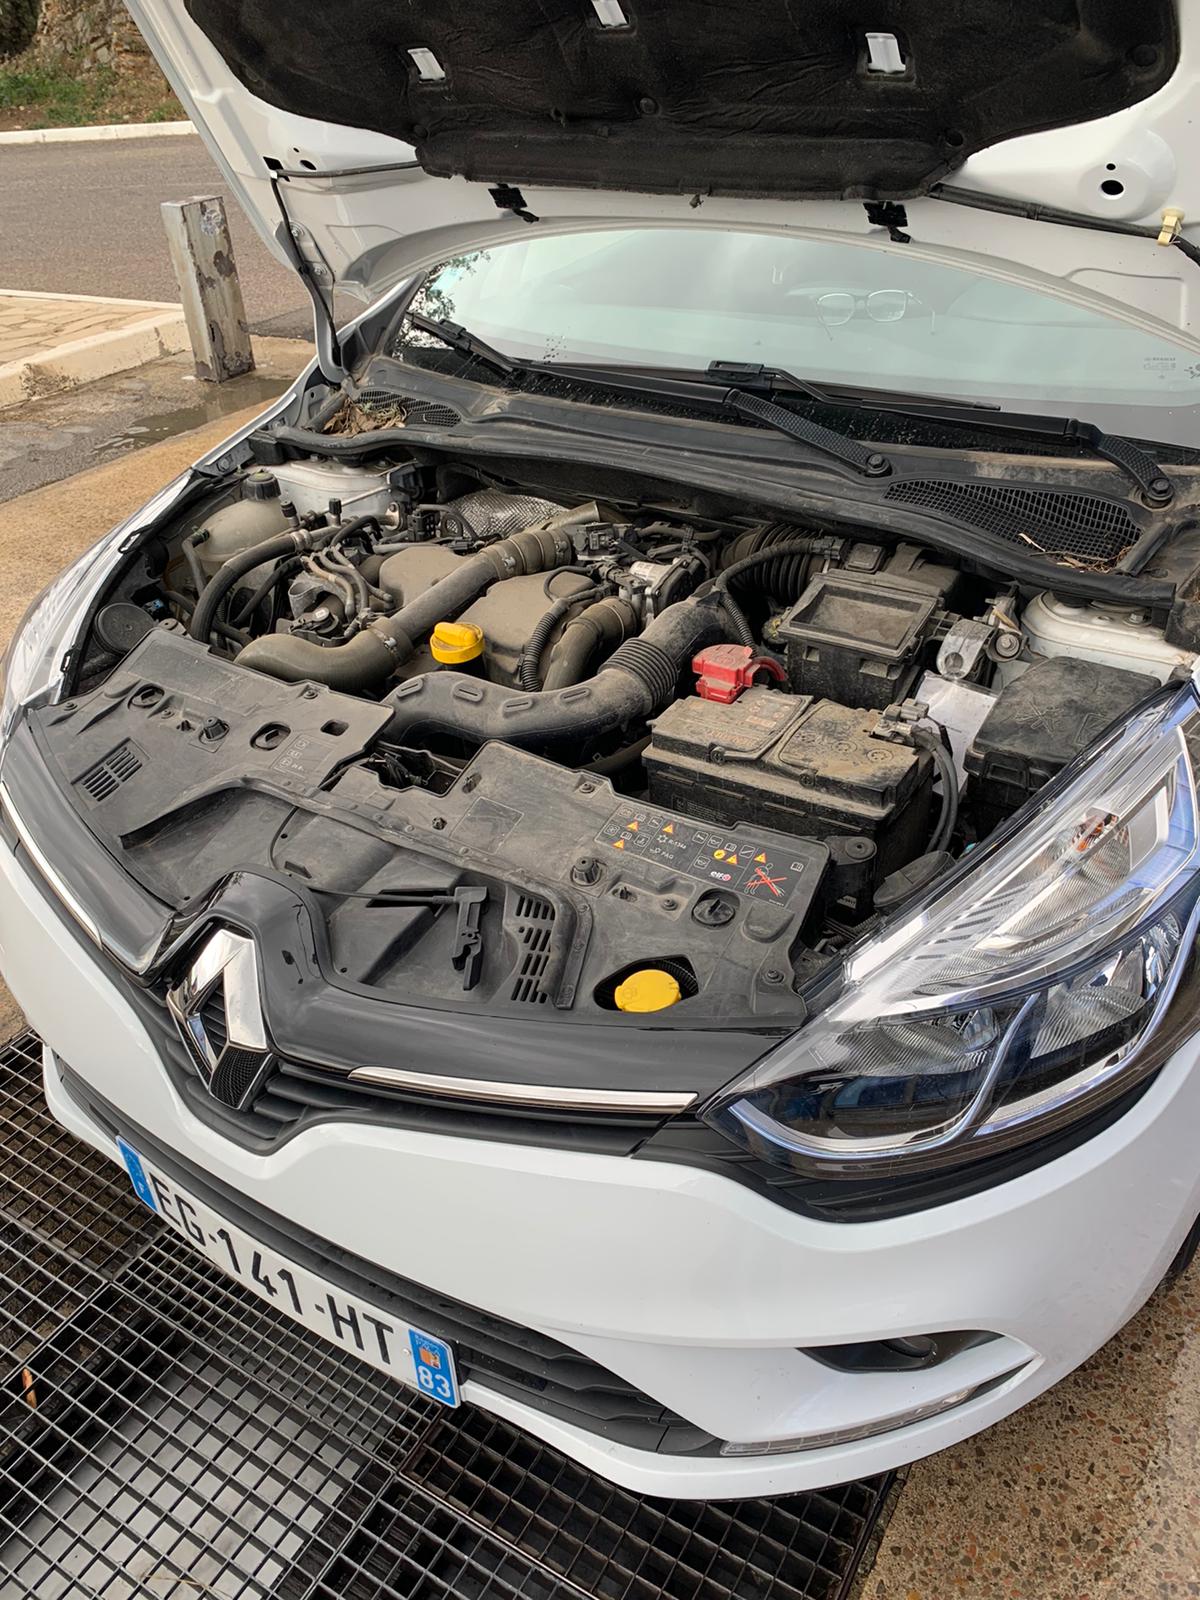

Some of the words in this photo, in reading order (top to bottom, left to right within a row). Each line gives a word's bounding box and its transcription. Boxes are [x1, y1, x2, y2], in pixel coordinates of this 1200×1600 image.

[710, 871, 724, 880] elf
[148, 1171, 395, 1366] EG-141-HT
[418, 1366, 451, 1398] 83
